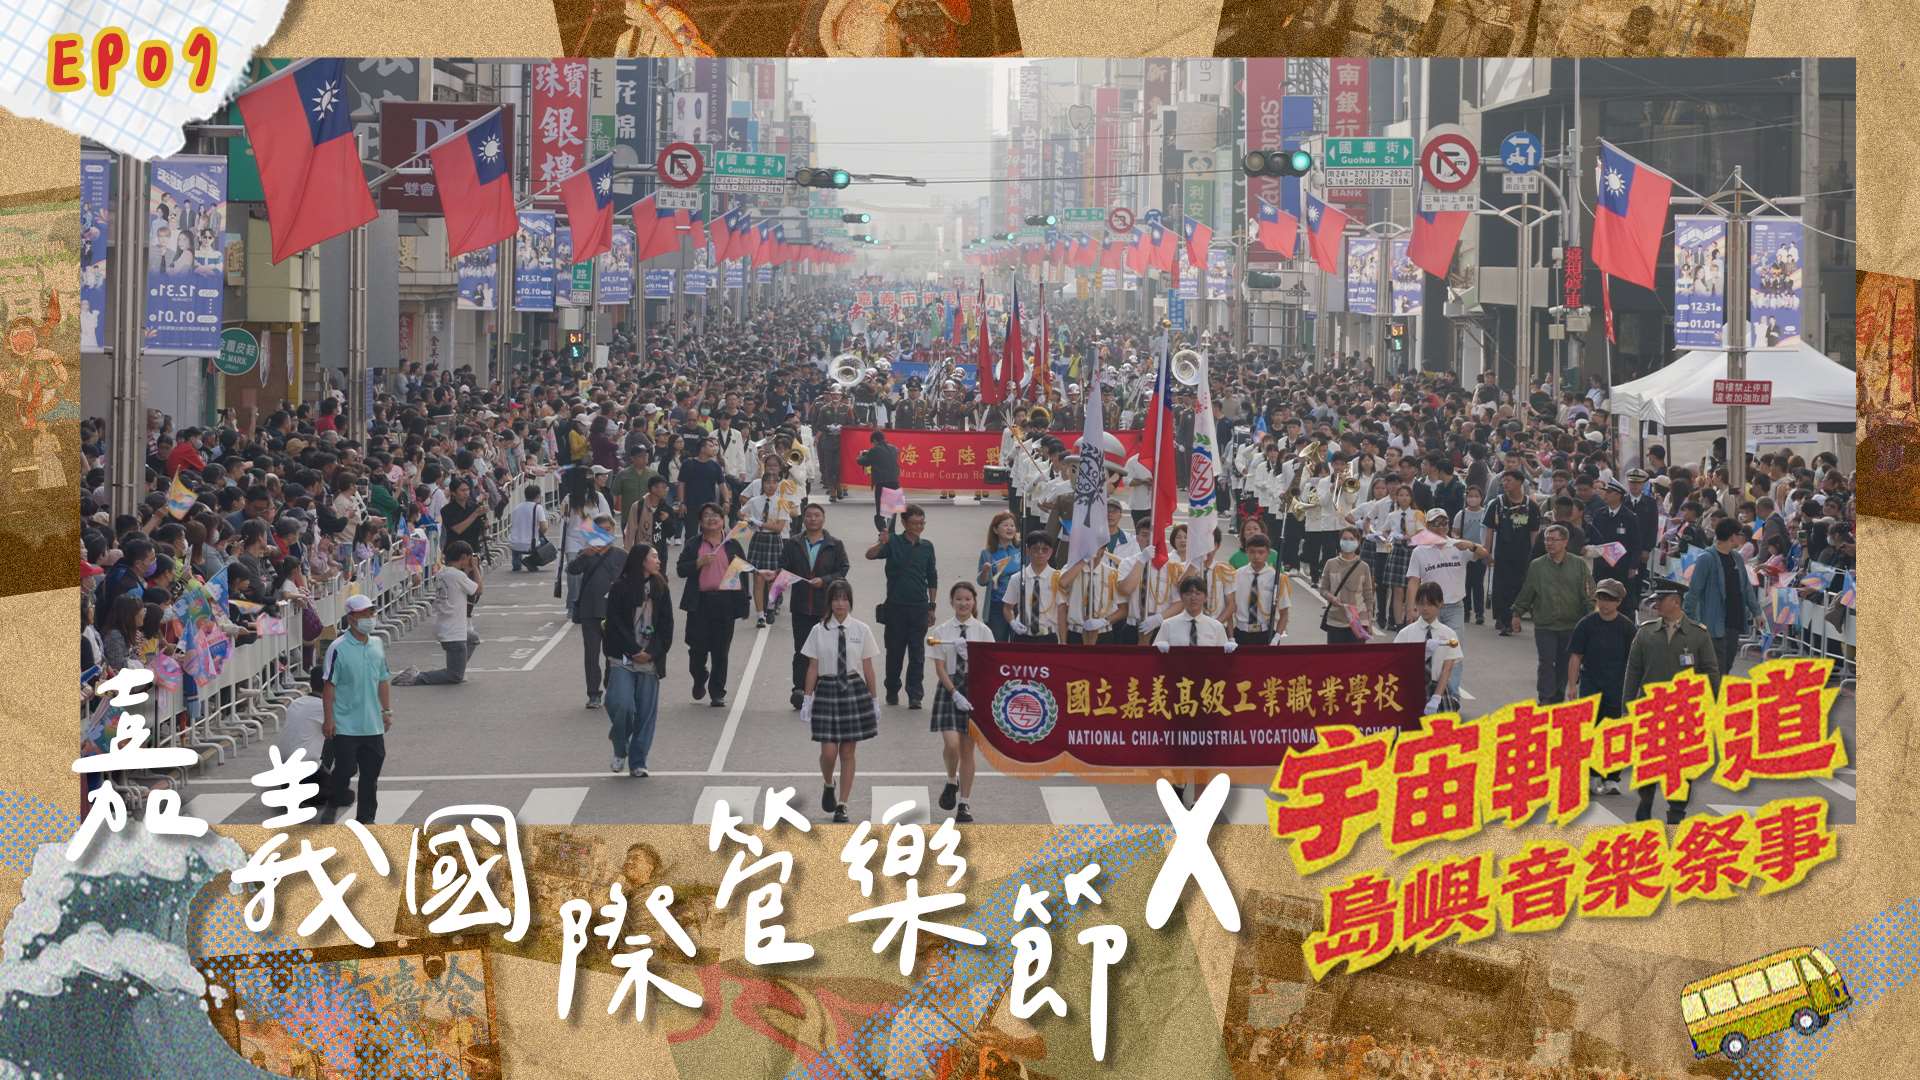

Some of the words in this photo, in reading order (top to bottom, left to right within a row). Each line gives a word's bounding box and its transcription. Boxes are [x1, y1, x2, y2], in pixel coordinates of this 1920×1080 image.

[1338, 141, 1400, 155] 國華街
[1340, 156, 1376, 165] Guohua
[387, 182, 437, 197] 一雙會
[1331, 189, 1363, 198] BANK
[1690, 302, 1716, 312] 12.31
[1690, 319, 1716, 329] 01.01
[939, 469, 969, 481] Corps
[1425, 565, 1436, 573] LOS
[1436, 561, 1461, 569] ANGELES
[1000, 664, 1051, 679] CYIVS
[1065, 674, 1404, 721] 國立嘉義高級工業職業學校
[1067, 729, 1126, 746] NATIONAL
[1131, 729, 1175, 746] CHIA-YI
[1177, 728, 1248, 746] INDUSTRIAL
[1249, 727, 1320, 745] VOCATIONA
